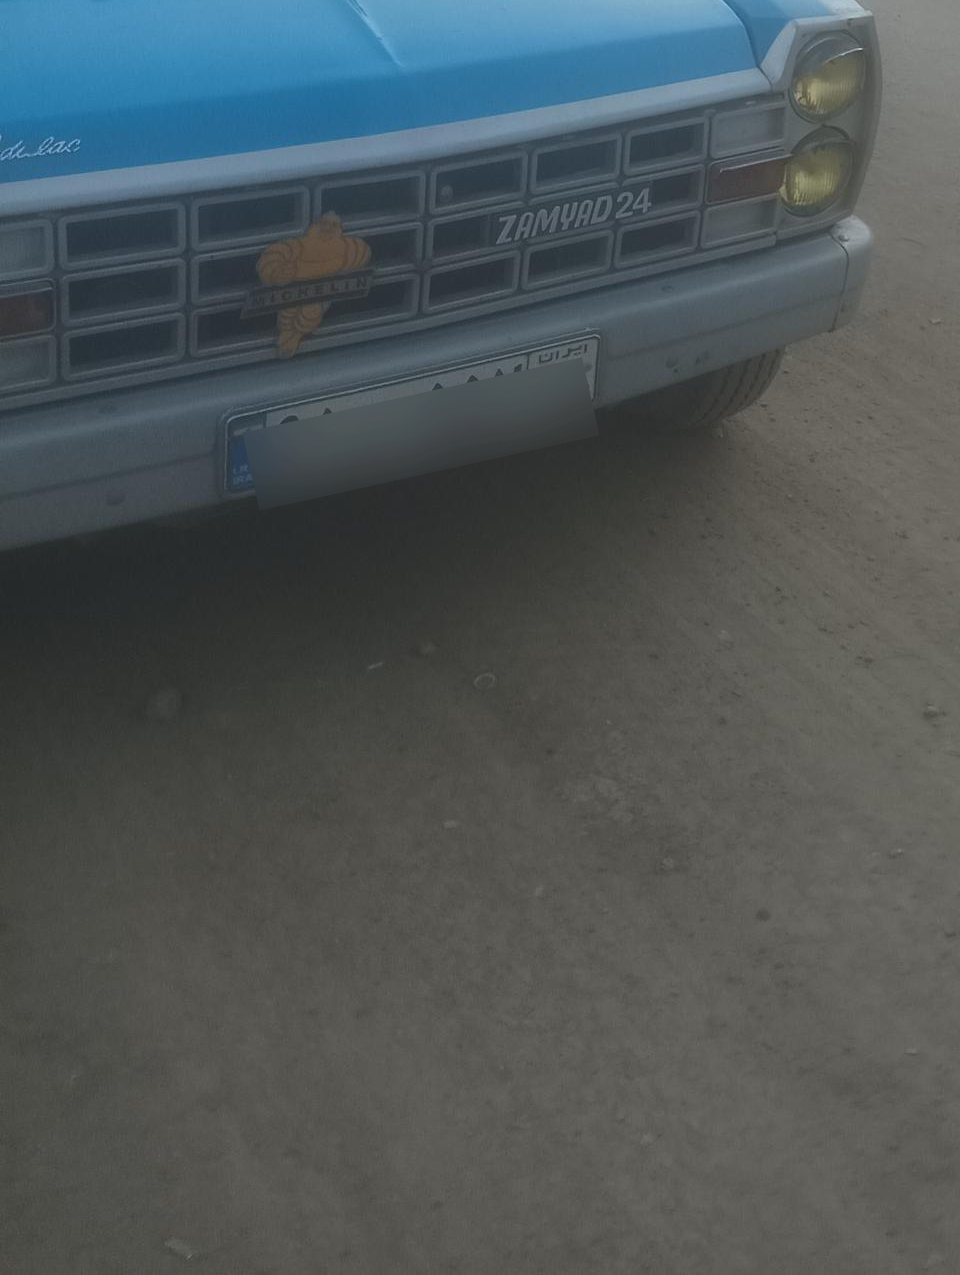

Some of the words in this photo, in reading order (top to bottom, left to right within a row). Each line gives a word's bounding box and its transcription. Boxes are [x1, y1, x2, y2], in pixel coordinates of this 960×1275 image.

[496, 194, 613, 245] ZAMYAD
[615, 188, 652, 219] 24
[253, 278, 368, 307] MICHELIN
[538, 343, 588, 366] ایران
[232, 474, 254, 486] IRA
